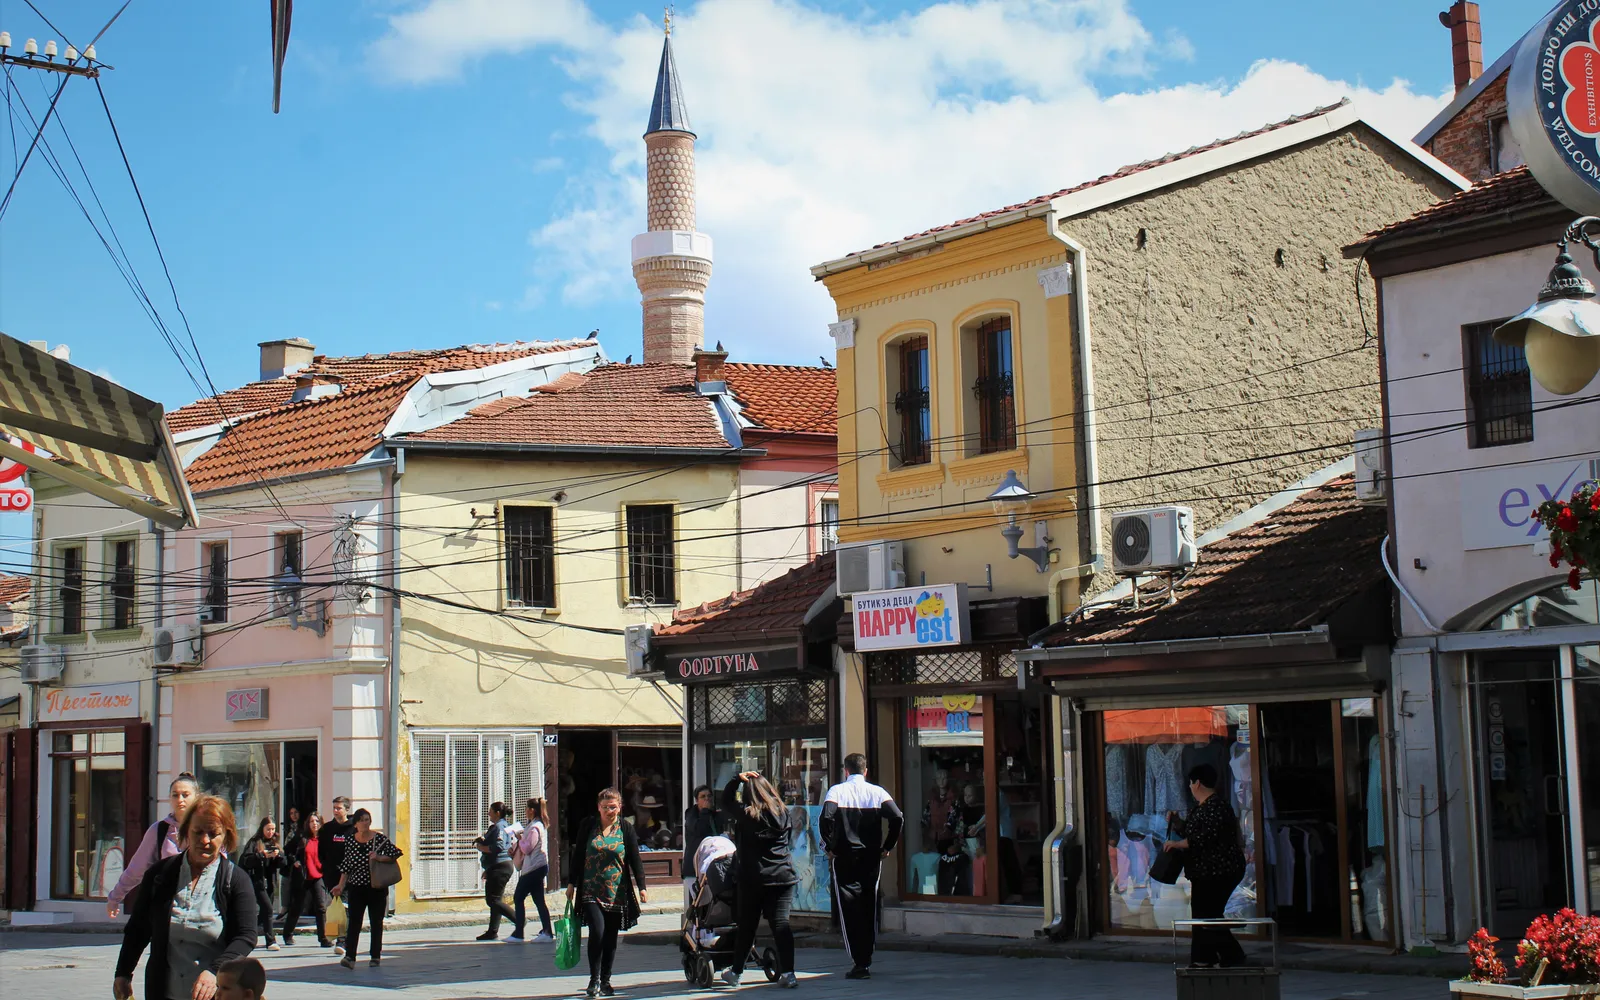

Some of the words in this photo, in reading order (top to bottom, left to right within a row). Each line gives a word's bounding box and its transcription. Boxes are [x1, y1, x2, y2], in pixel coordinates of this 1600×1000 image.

[1541, 36, 1561, 95] ДОБРО
[1555, 12, 1577, 37] НИ
[1577, 0, 1600, 19] ДО
[1584, 52, 1597, 127] EXHIBITIONS
[857, 599, 881, 610] БУТИК
[882, 598, 891, 608] ЗА
[893, 595, 913, 608] ДЕЦА
[678, 652, 760, 678] ФОРТУНА
[46, 689, 133, 716] Престиж
[227, 691, 260, 717] SIX
[544, 735, 555, 743] 47
